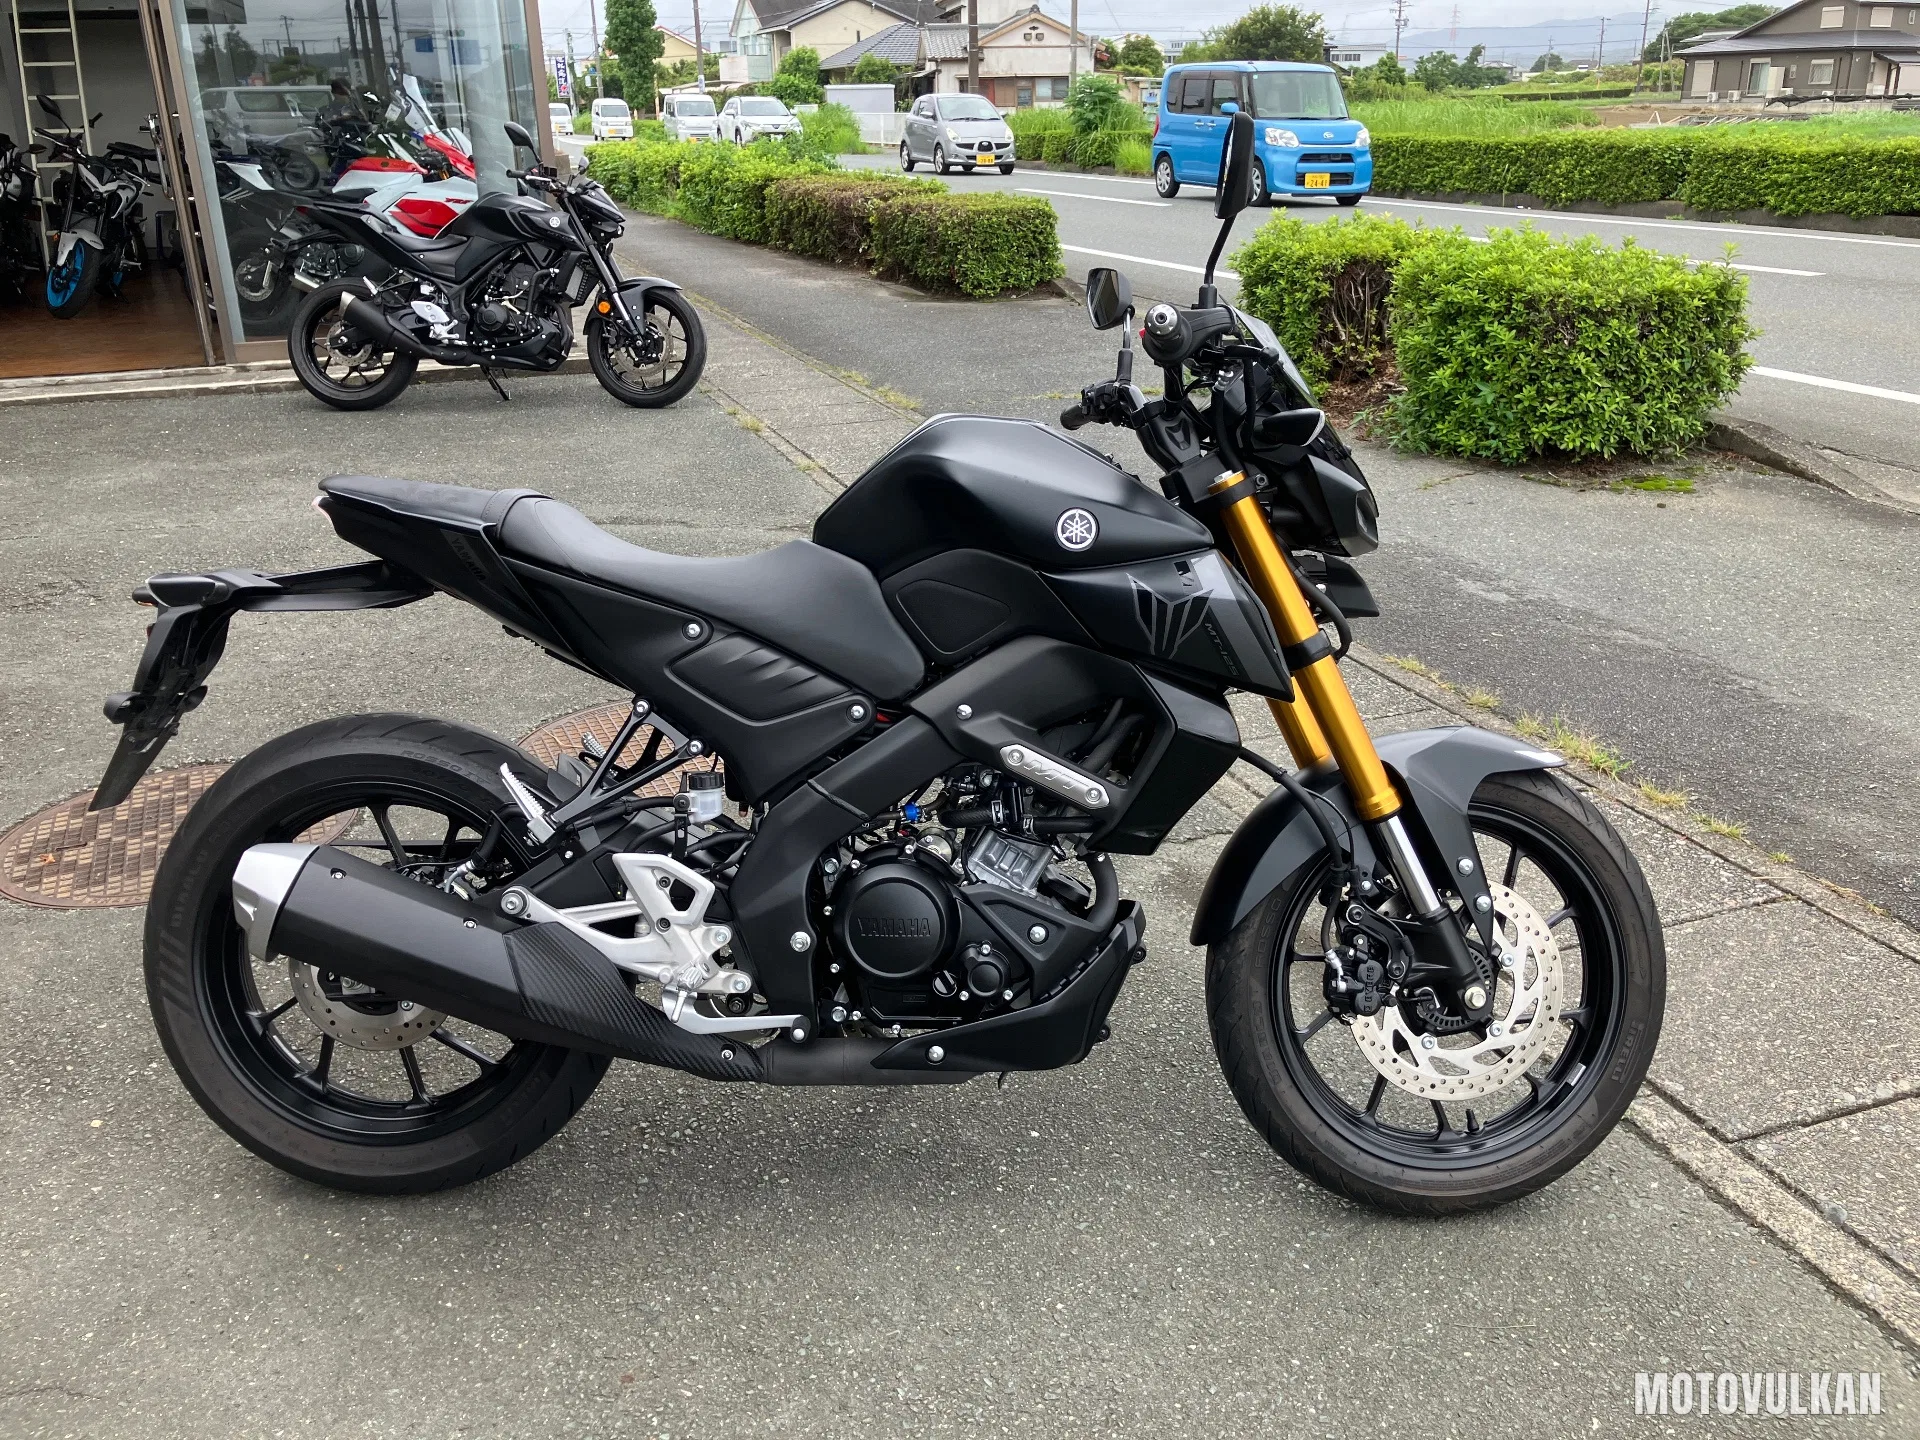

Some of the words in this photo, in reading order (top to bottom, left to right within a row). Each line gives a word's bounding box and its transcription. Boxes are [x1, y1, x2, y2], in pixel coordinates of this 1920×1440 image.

[451, 537, 487, 581] YAMAHA
[1204, 623, 1240, 676] MT-125
[400, 749, 463, 773] ROSSO
[1023, 759, 1090, 790] MT
[857, 917, 931, 938] YAMAHA
[1254, 897, 1283, 970] ROSSO
